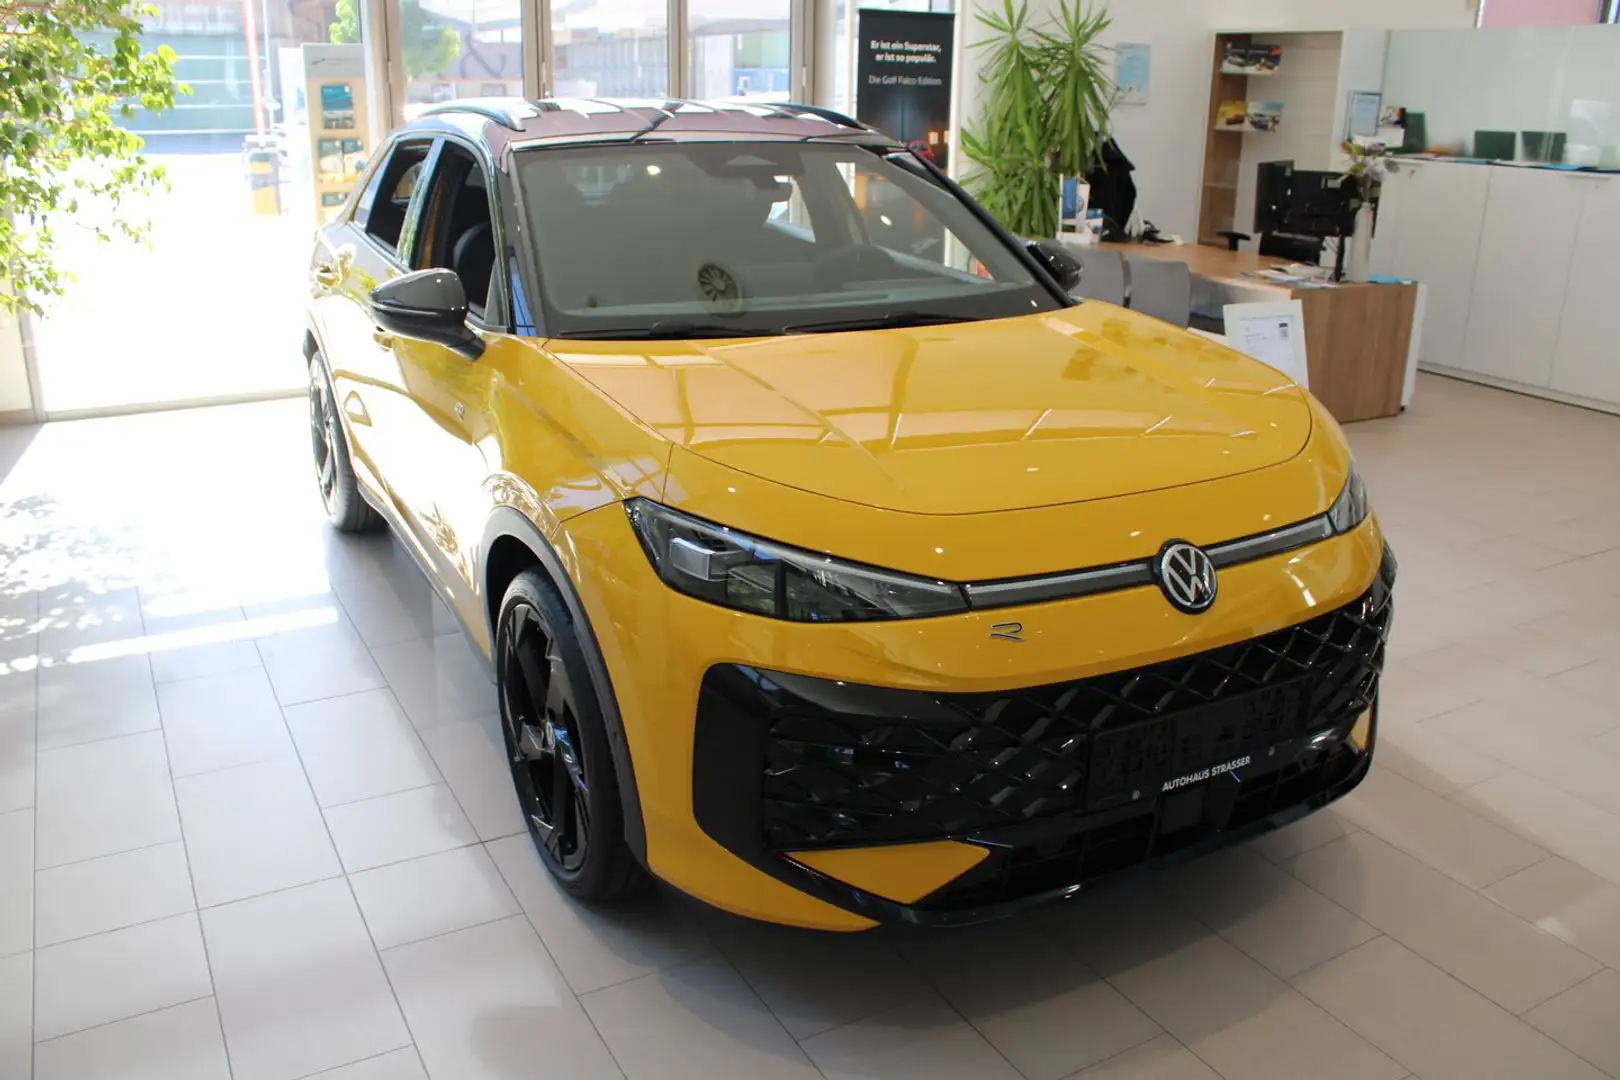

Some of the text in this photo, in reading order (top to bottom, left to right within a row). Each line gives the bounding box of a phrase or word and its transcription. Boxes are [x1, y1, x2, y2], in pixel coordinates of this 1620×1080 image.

[870, 40, 942, 53] Er ist ein Superstar,
[885, 52, 895, 61] ist
[905, 53, 936, 64] populär.
[868, 75, 881, 85] Die
[882, 75, 898, 85] Golf
[918, 76, 943, 86] Edition
[1162, 545, 1216, 607] VW
[1161, 755, 1251, 792] AUTOHAUS STRASSER
